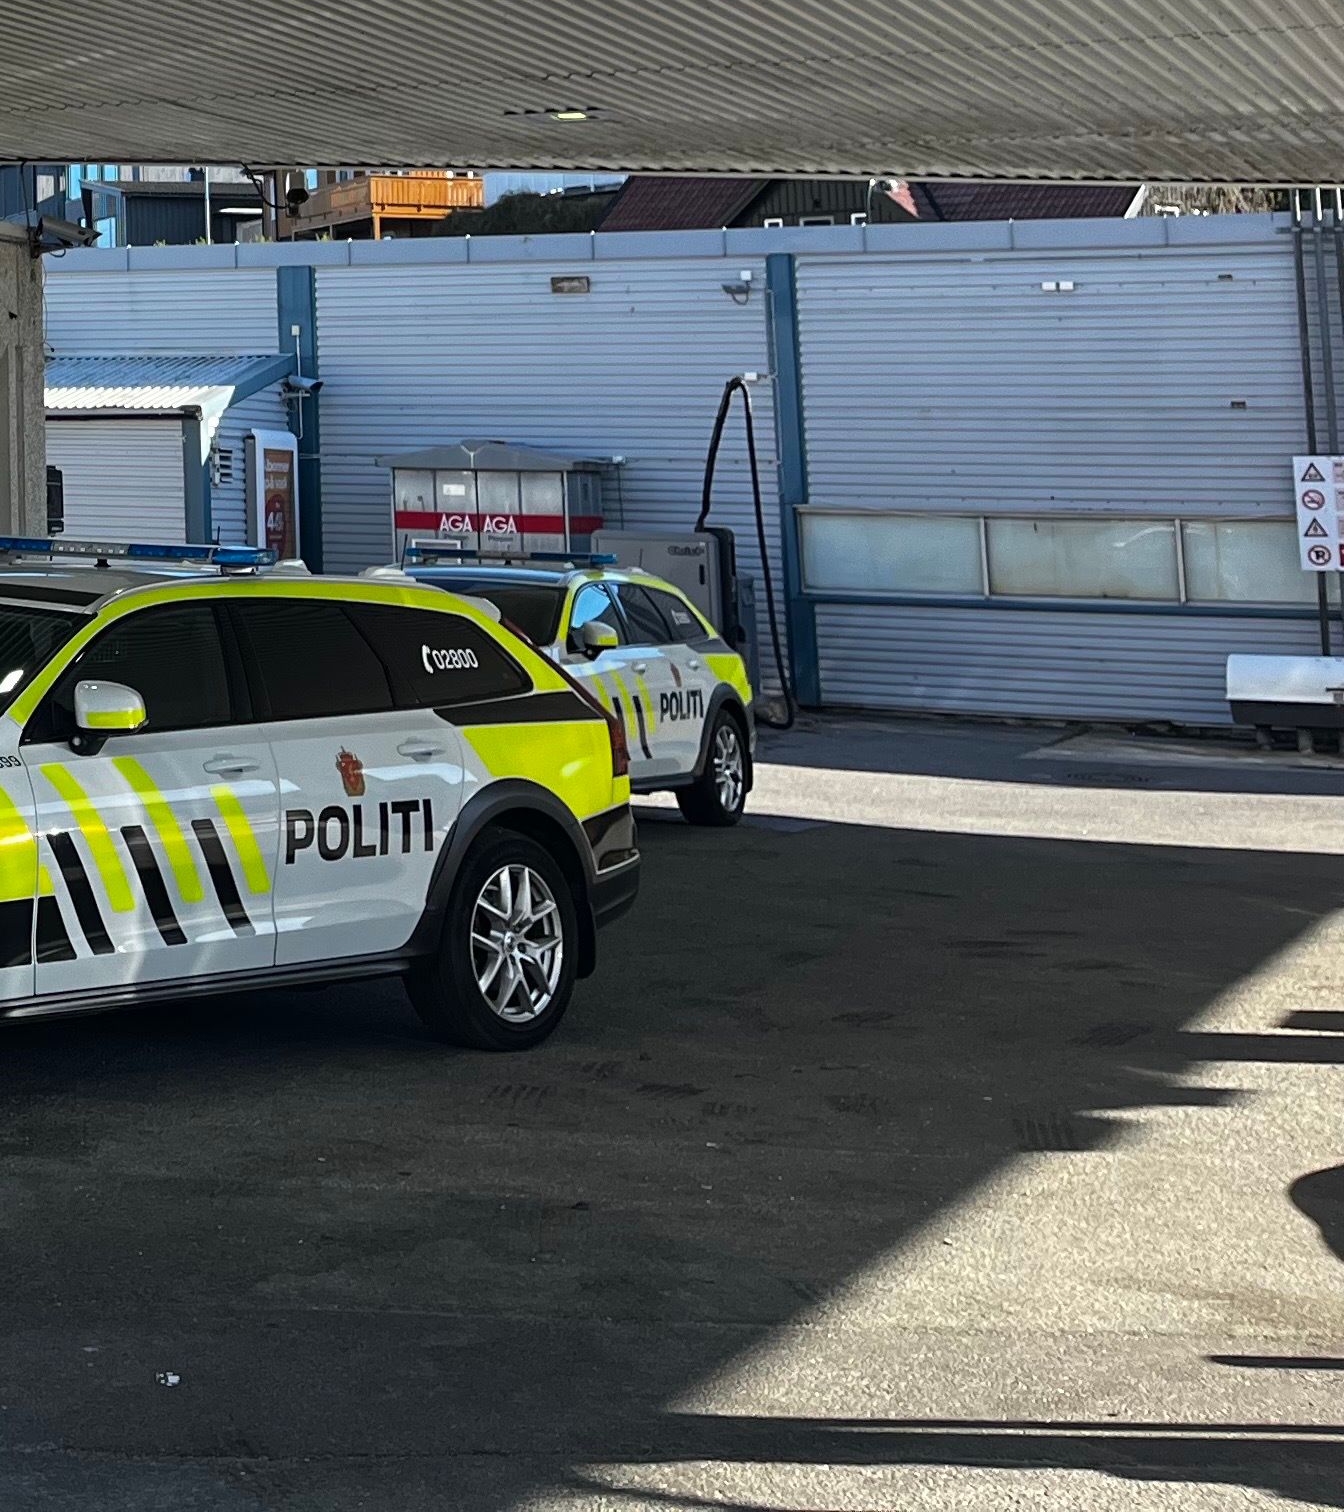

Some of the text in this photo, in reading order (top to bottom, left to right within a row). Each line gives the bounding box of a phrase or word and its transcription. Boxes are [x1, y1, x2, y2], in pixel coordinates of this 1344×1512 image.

[439, 513, 473, 533] AGA
[483, 515, 517, 534] AGA
[433, 648, 478, 670] 02800
[660, 689, 703, 723] POLITI
[285, 798, 435, 865] POLITI
